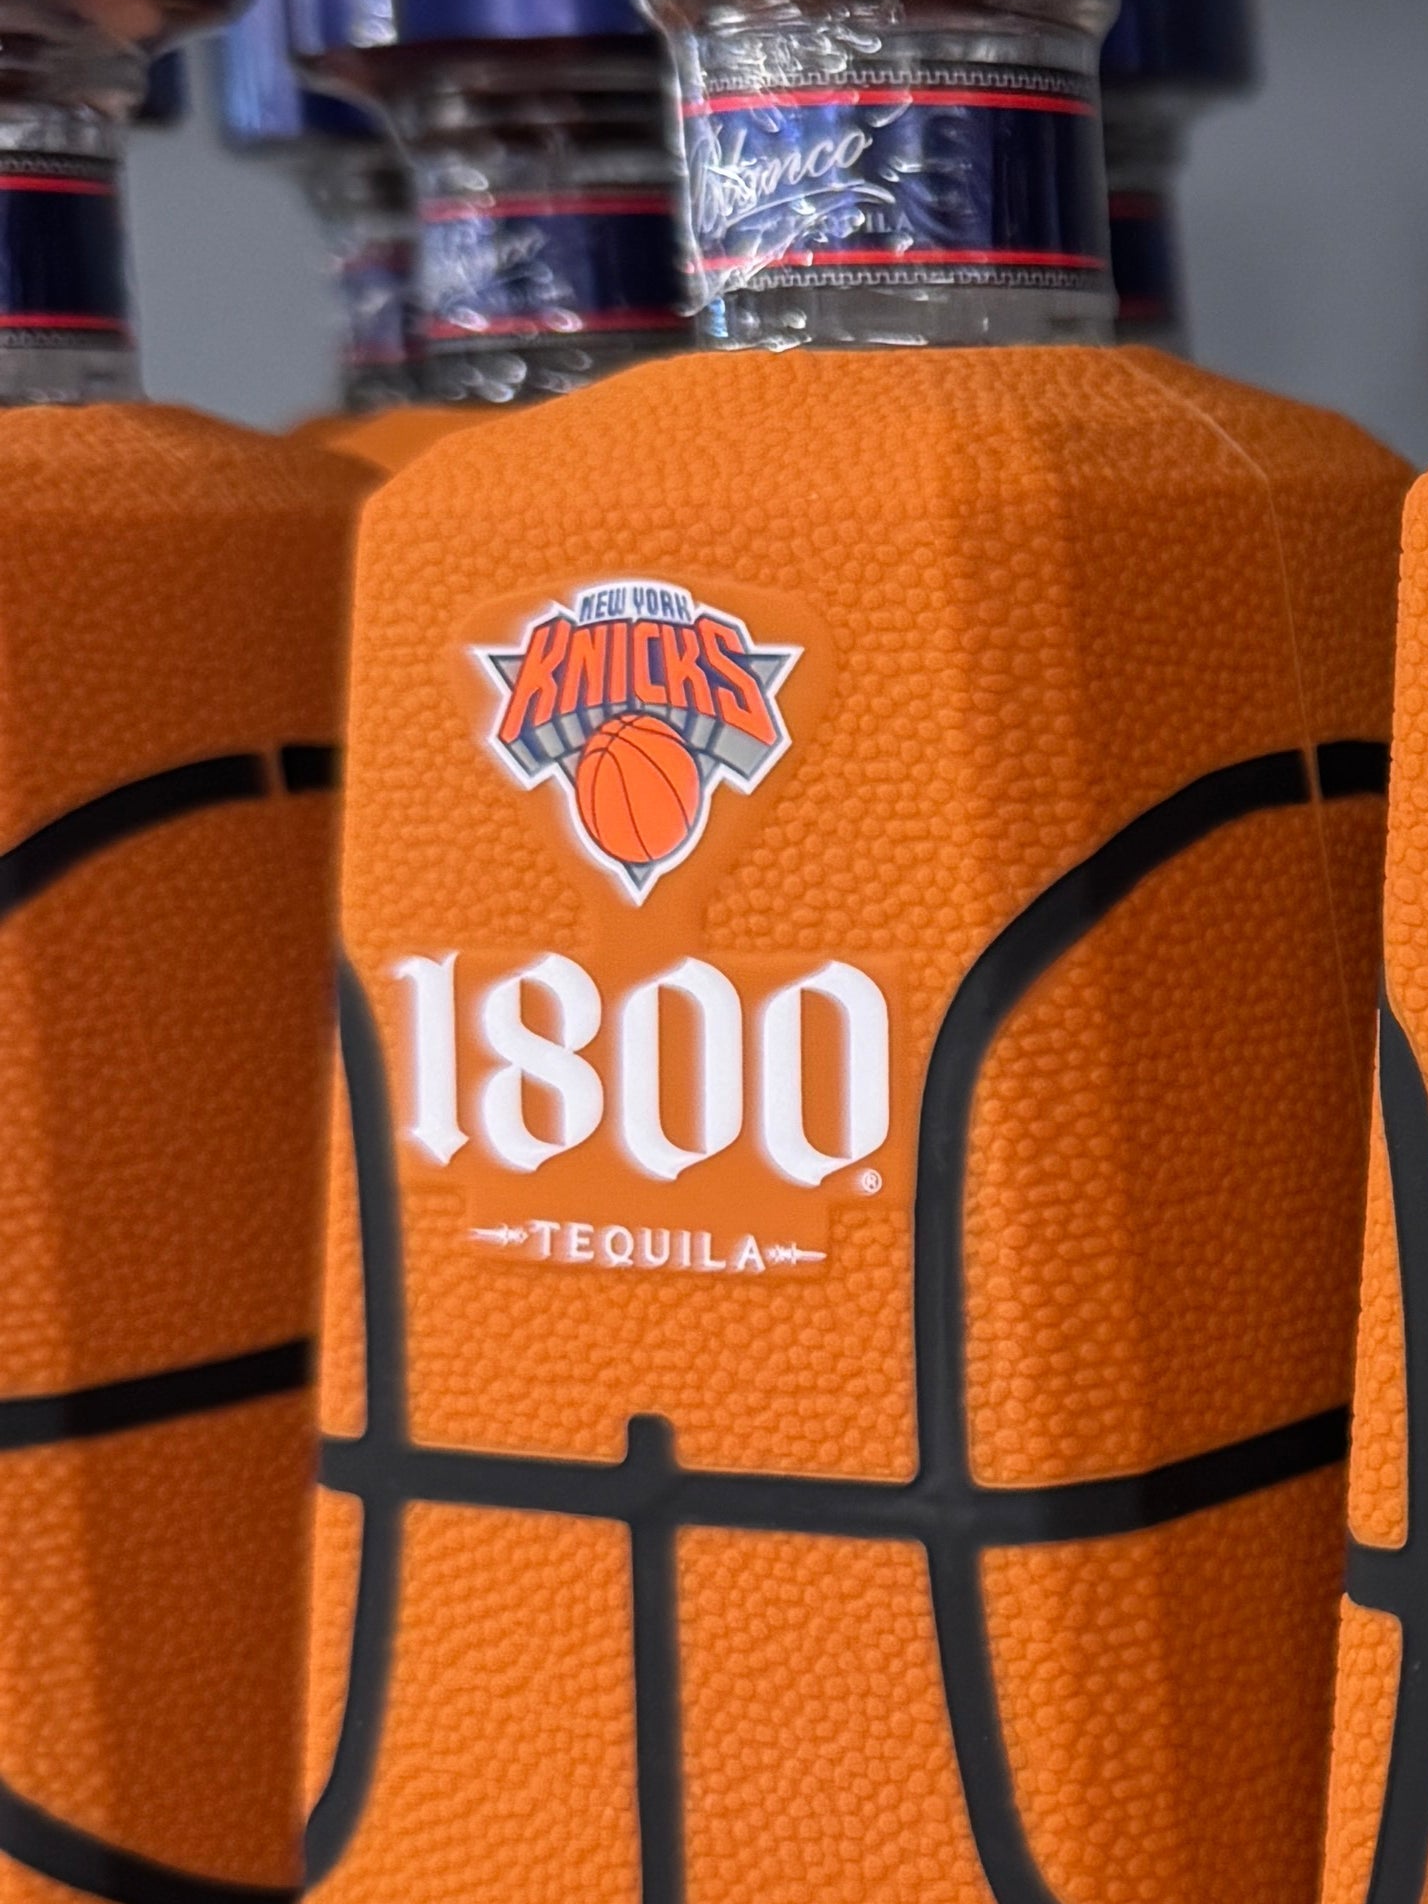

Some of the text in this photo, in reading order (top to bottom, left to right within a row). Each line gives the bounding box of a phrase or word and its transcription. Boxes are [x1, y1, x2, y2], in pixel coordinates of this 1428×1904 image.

[579, 586, 693, 623] NEW YORK
[500, 616, 777, 747] KNICKS
[392, 950, 889, 1188] 1800
[530, 1218, 767, 1273] TEQUILA
